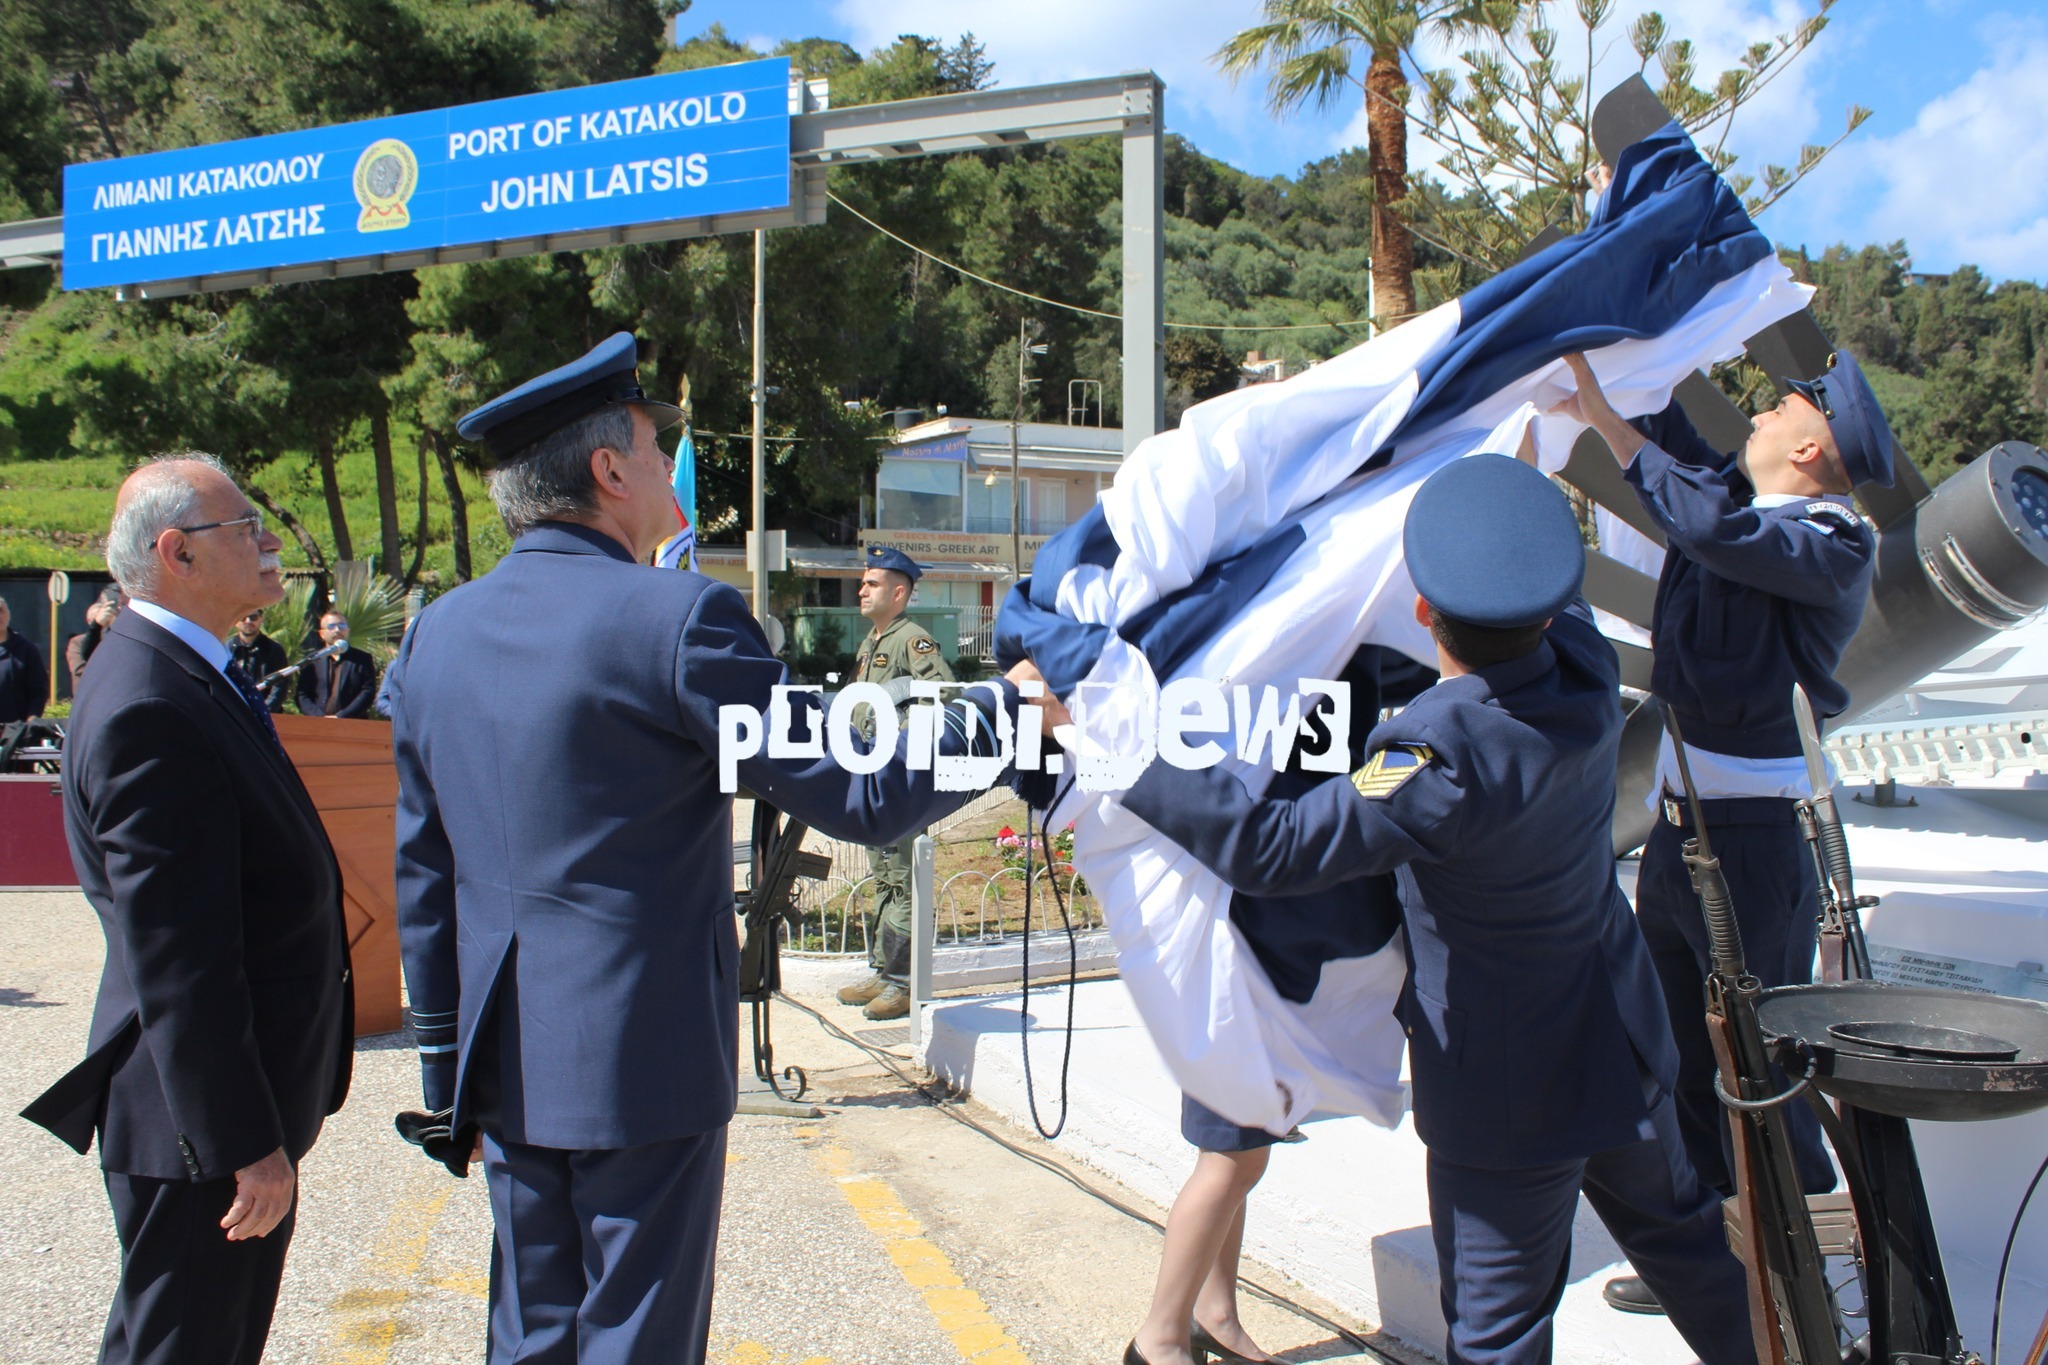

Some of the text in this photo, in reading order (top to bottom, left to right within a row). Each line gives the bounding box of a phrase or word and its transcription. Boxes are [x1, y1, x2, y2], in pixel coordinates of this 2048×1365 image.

[449, 91, 747, 160] PORT OF KATAKOLO
[93, 152, 325, 211] ΛΙΜΑΝΙ ΚΑΤΑΚΟΛΟΥ
[481, 152, 709, 213] JOHN LATSIS
[91, 203, 326, 263] ΓΙΑΝΝΗΣ ΛΑΤΣΗΣ
[979, 545, 1000, 555] ART
